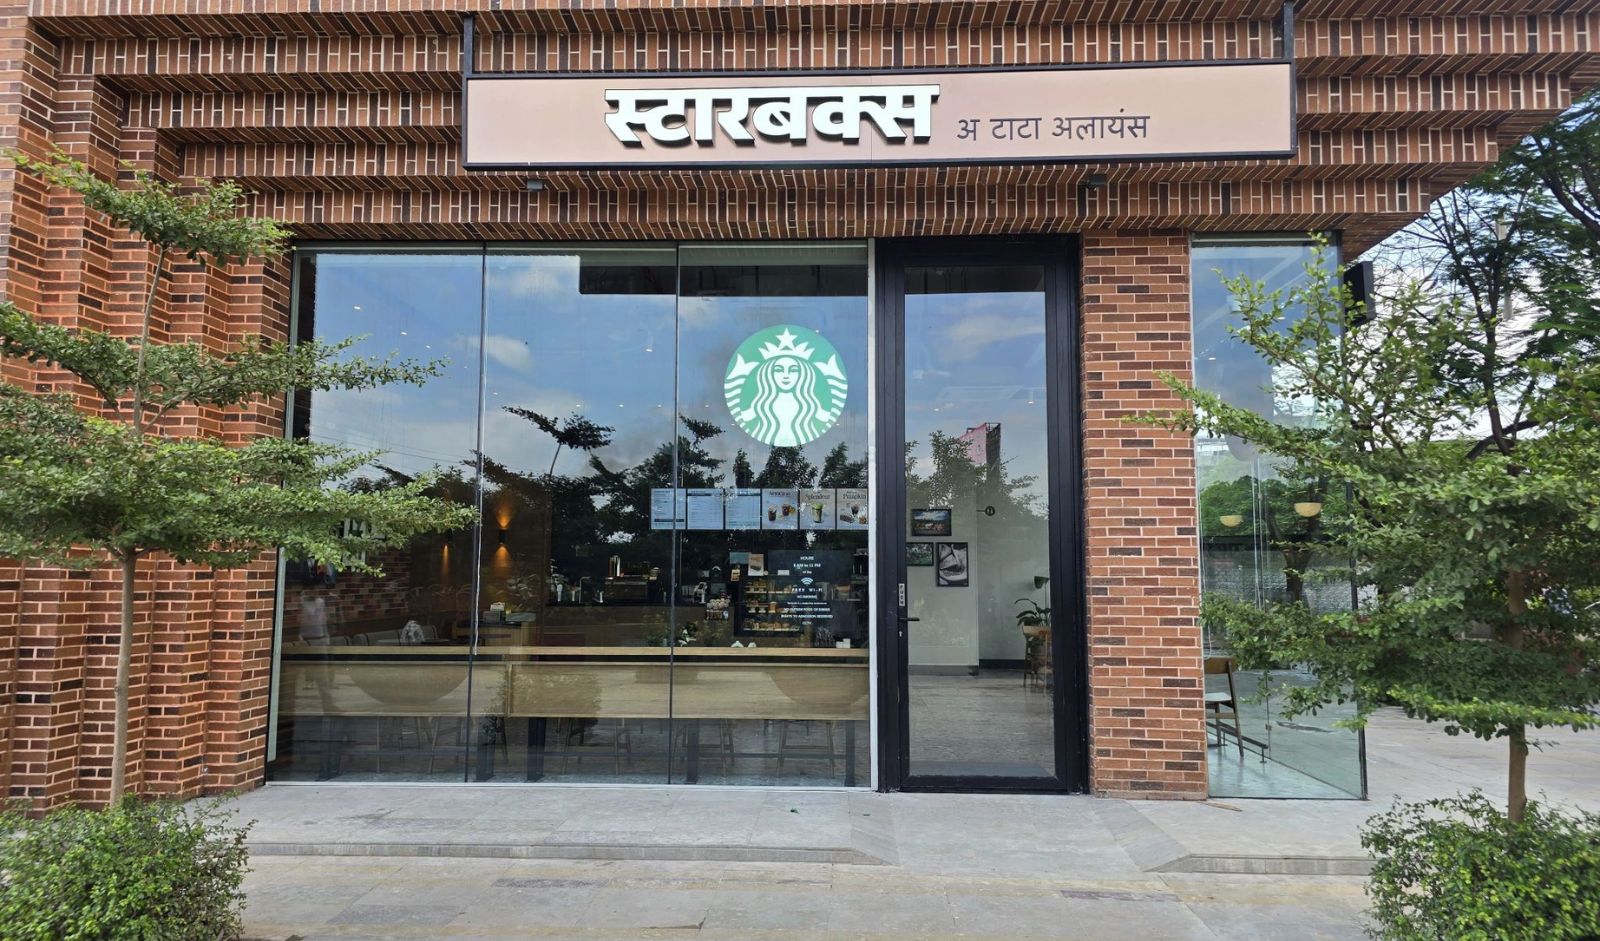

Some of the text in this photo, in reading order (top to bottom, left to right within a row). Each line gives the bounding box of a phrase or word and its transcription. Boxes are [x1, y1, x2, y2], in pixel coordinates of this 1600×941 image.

[604, 85, 1150, 147] स्टारबक्स अ टाटा अलायंस
